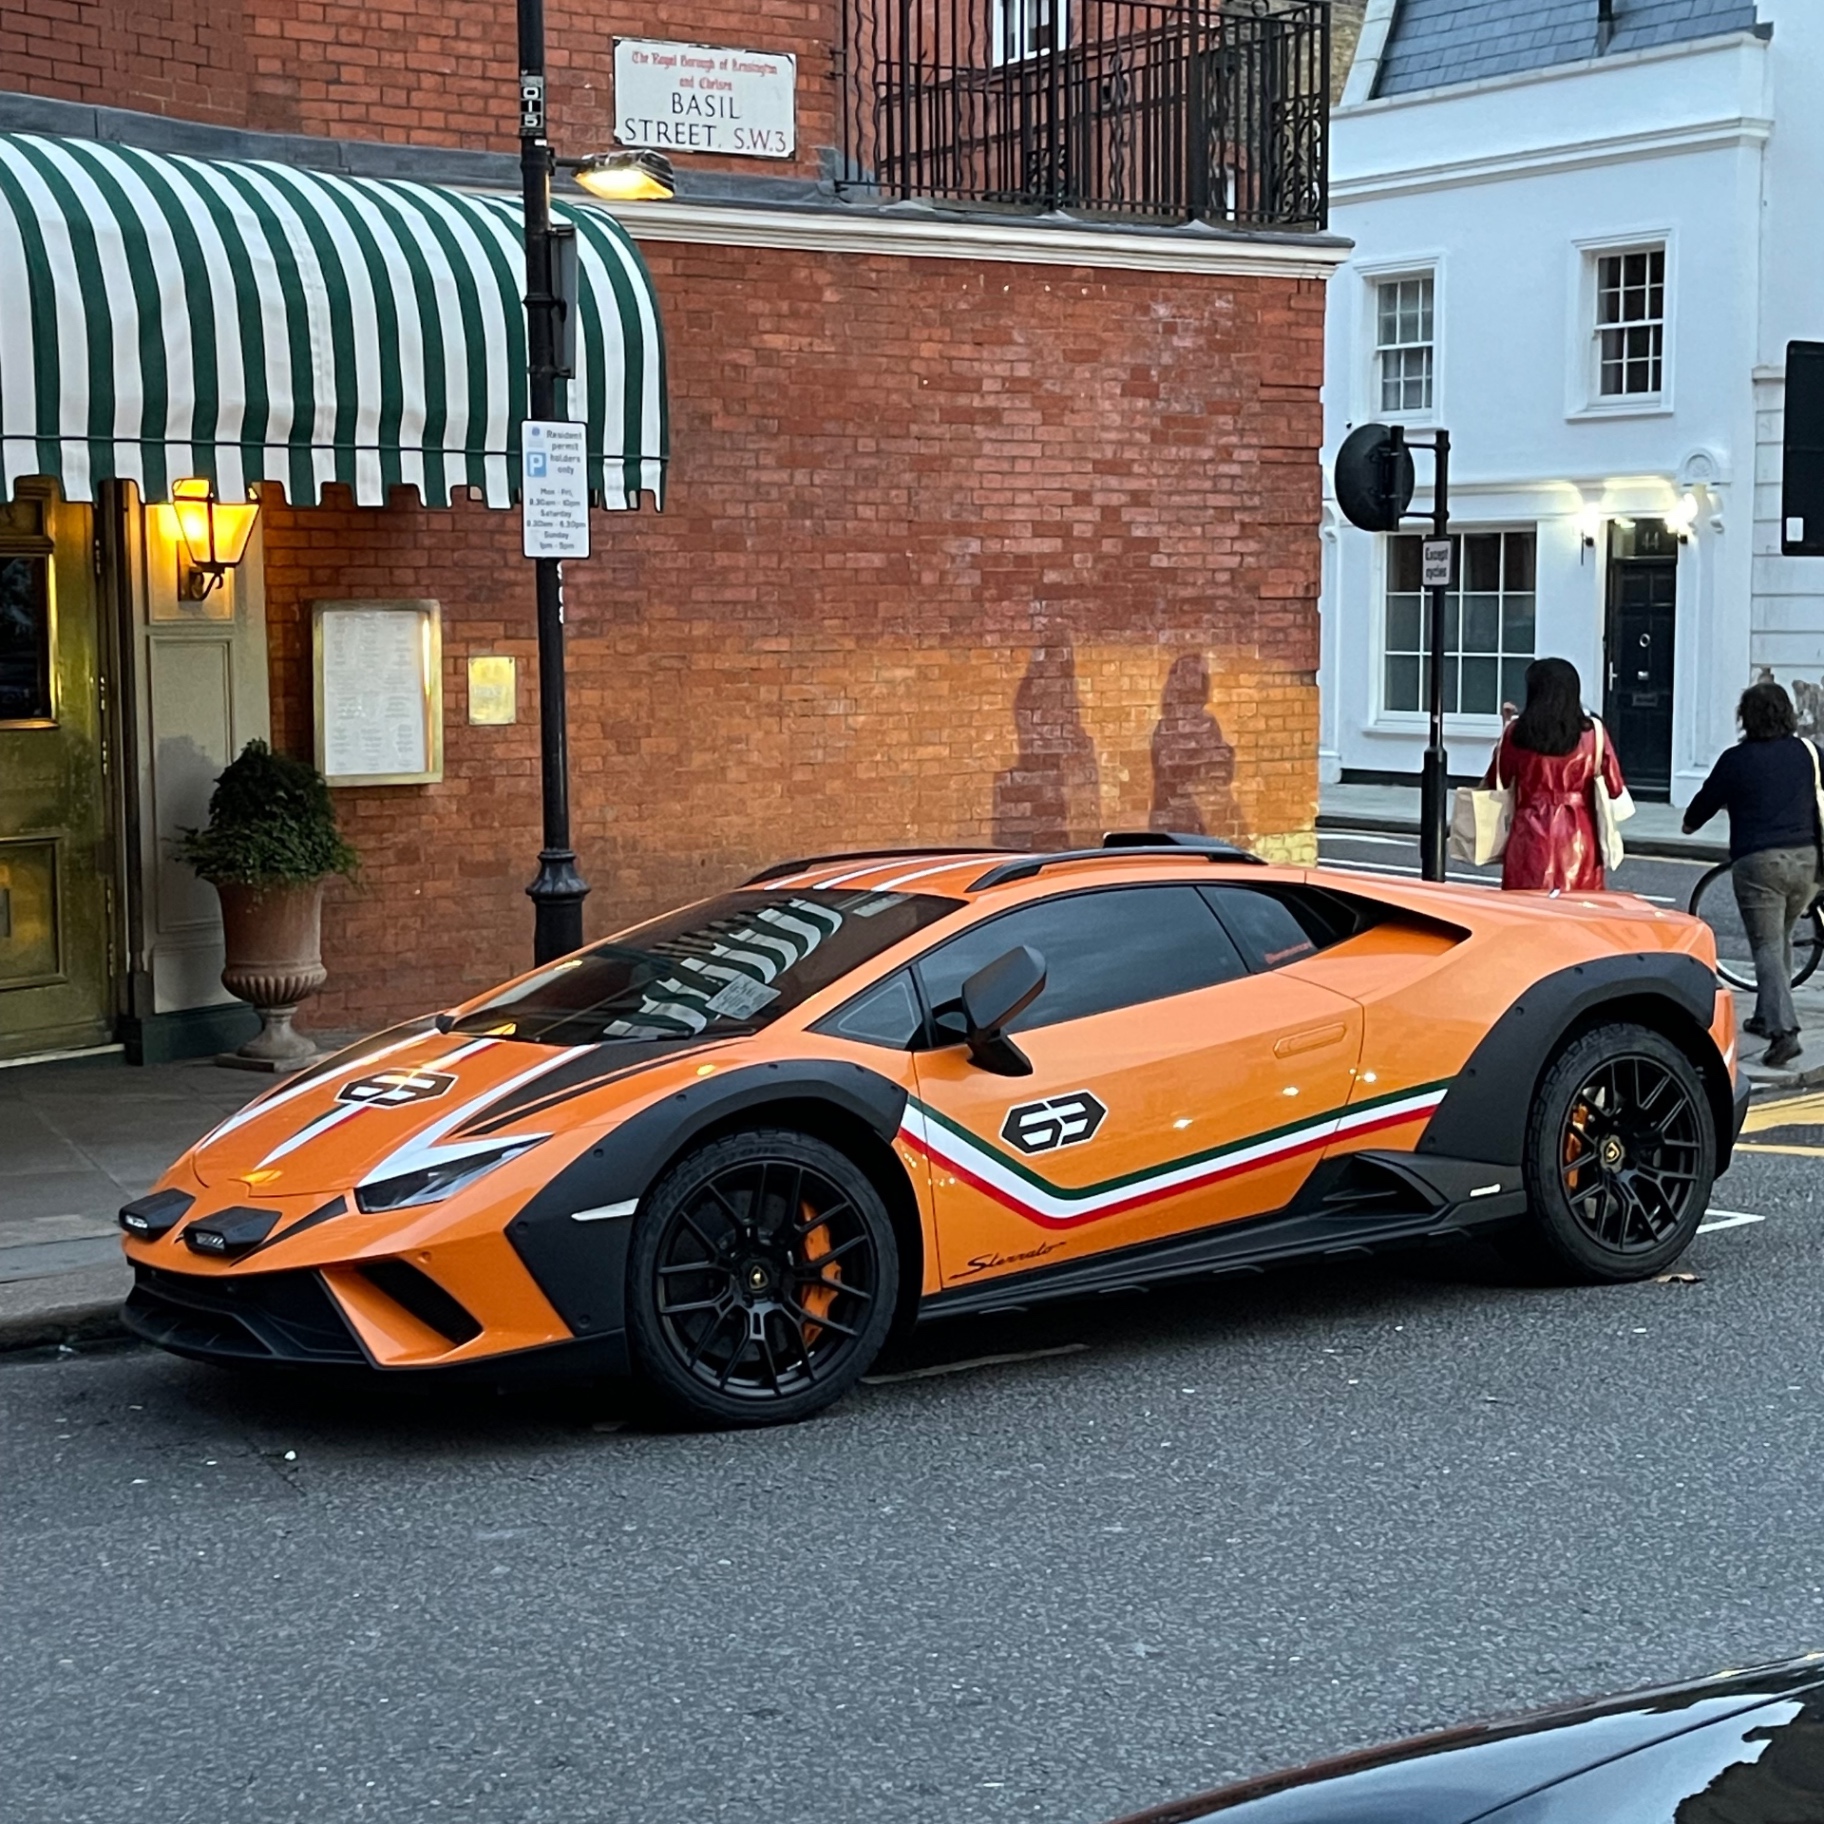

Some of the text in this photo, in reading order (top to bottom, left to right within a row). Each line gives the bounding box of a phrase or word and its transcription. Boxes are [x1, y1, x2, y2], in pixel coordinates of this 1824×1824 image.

[631, 50, 778, 77] The Royal Borough of Kensington
[679, 76, 733, 91] and Chelsea
[671, 92, 742, 120] BASIL
[733, 127, 787, 153] S.W.3
[546, 429, 582, 440] Resident
[551, 442, 579, 451] permit
[550, 454, 581, 463] holders
[529, 454, 544, 477] P
[557, 466, 574, 475] only
[540, 509, 572, 518] Saturday
[543, 530, 570, 540] Sunday
[948, 1241, 1067, 1281] Sterrato
